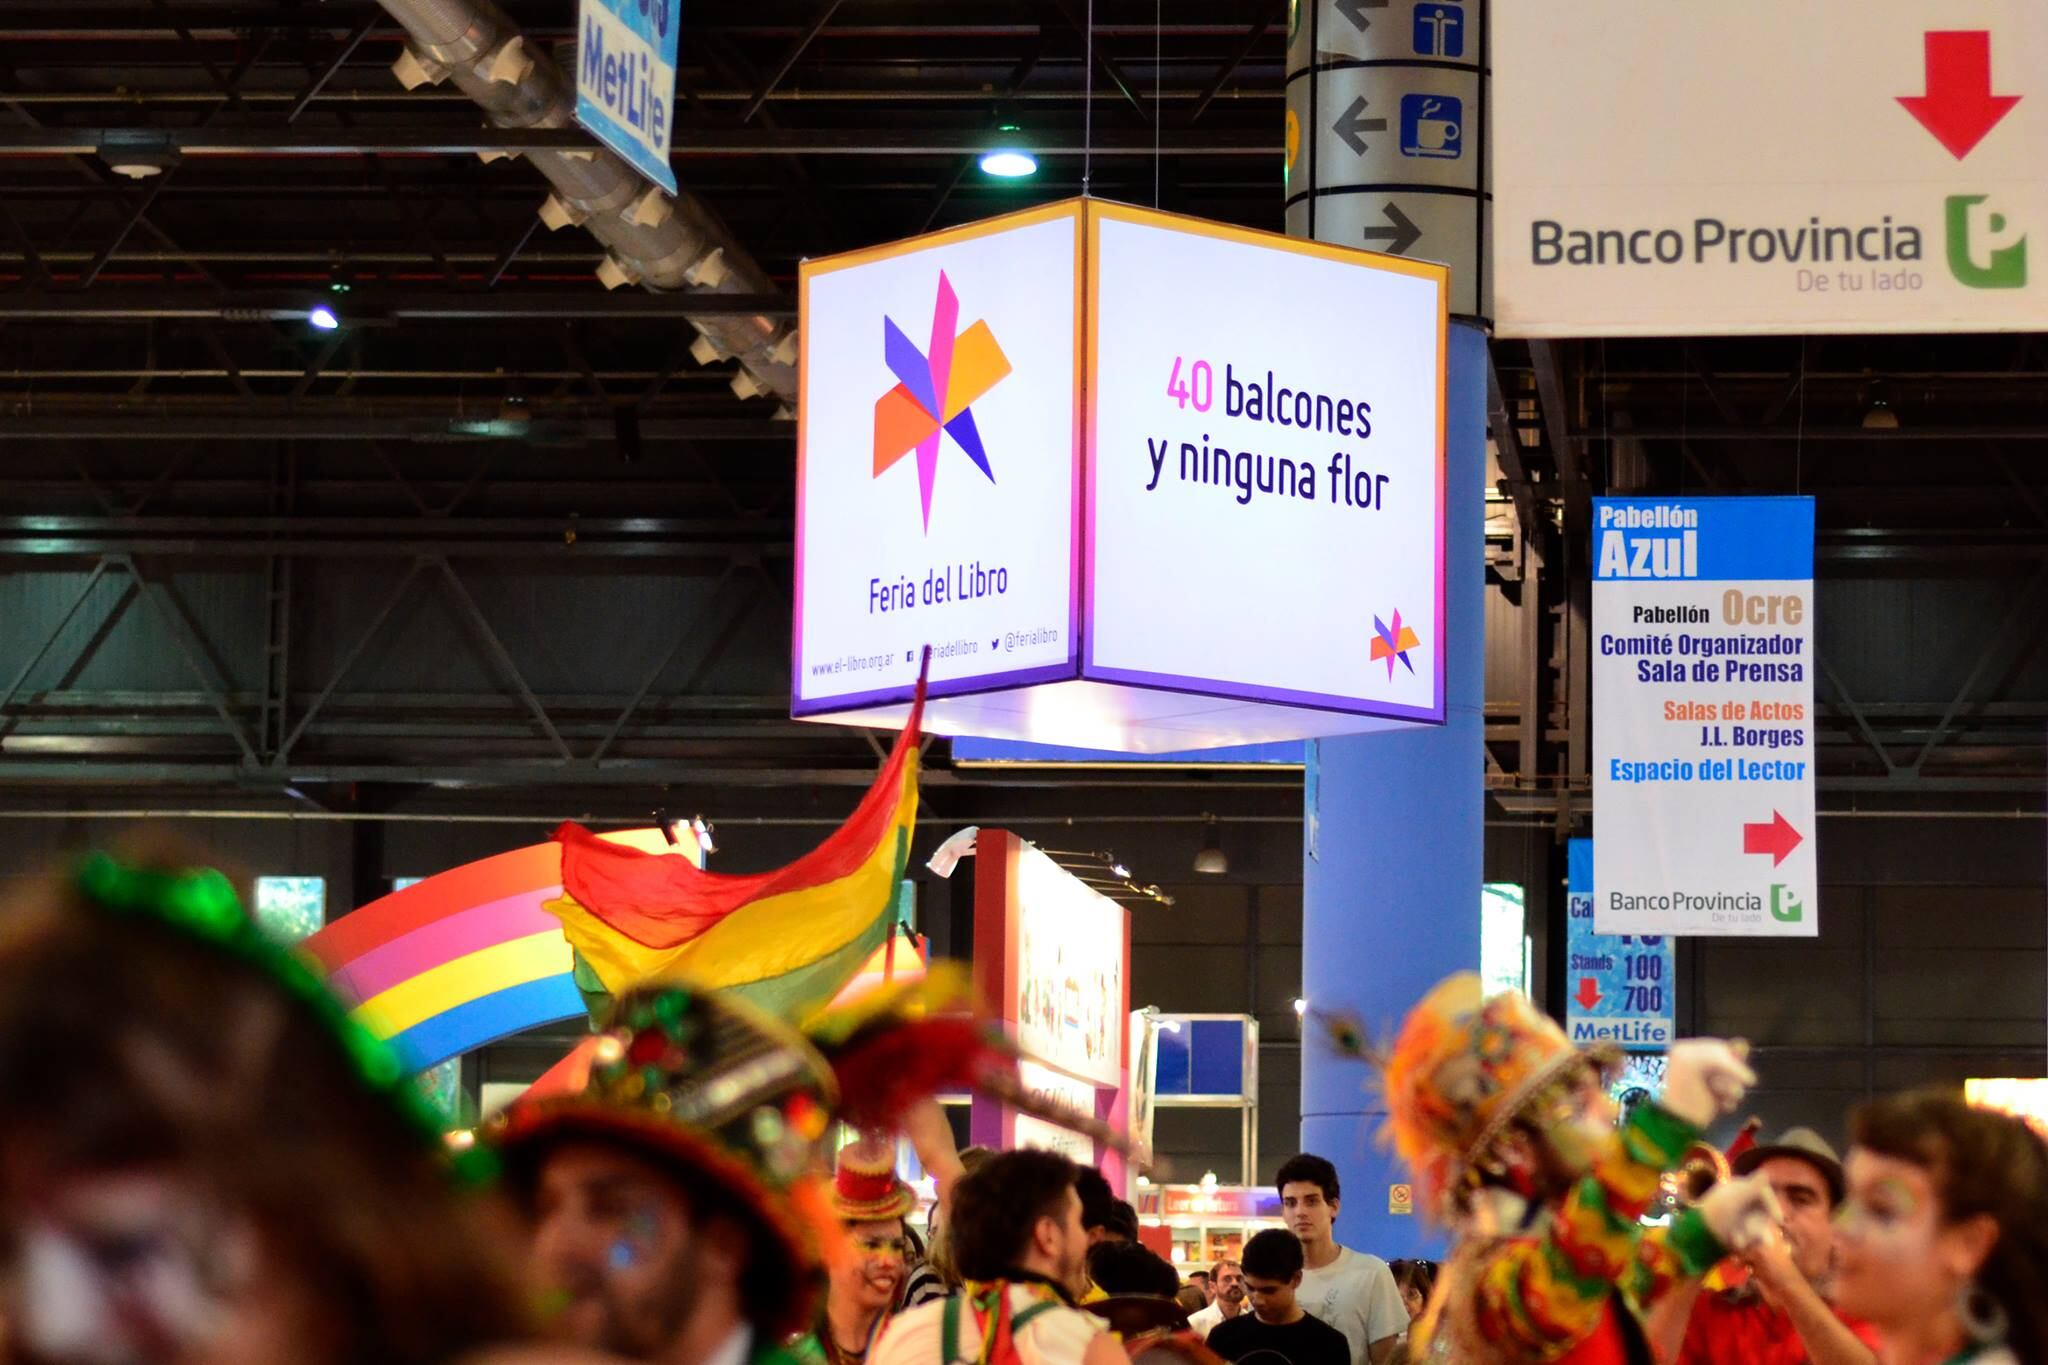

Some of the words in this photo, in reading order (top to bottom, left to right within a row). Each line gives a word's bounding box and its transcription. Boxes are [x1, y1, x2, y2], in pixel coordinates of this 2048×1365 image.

[582, 14, 664, 148] MetLife
[1532, 219, 1683, 266] Banco
[1694, 215, 1922, 264] Provincia
[1796, 269, 1829, 292] De
[1838, 270, 1864, 292] tu
[1870, 268, 1923, 292] lado
[1167, 356, 1212, 412] 40
[1225, 363, 1372, 439] balcones
[1146, 437, 1168, 491] y
[1180, 433, 1315, 505] ninguna
[1328, 452, 1389, 511] flor
[1600, 504, 1698, 529] Pabellón
[1598, 530, 1698, 578] Azul
[869, 575, 915, 614] Feria
[922, 566, 951, 606] del
[958, 560, 1008, 601] Libro
[1633, 605, 1710, 624] Pabellón
[1722, 589, 1803, 625] Ocre
[1004, 628, 1058, 653] @ferialibro
[1601, 634, 1672, 656] Comité
[1678, 634, 1803, 657] Organizador
[1637, 660, 1686, 683] Sala
[1692, 660, 1719, 683] de
[1725, 660, 1803, 683] Prensa
[1664, 701, 1717, 721] Salas
[1721, 701, 1745, 721] de
[1750, 701, 1804, 721] Actos
[1700, 727, 1728, 747] J.L.
[1733, 727, 1804, 749] Borges
[1611, 759, 1692, 783] Espacio
[1697, 759, 1732, 781] del
[1738, 759, 1805, 781] Lector
[1610, 892, 1670, 911] Banco
[1673, 892, 1762, 911] Provincia
[1571, 954, 1613, 971] Stands
[1624, 955, 1662, 980] 100
[1623, 986, 1662, 1012] 700
[1574, 1021, 1666, 1041] MetLife
